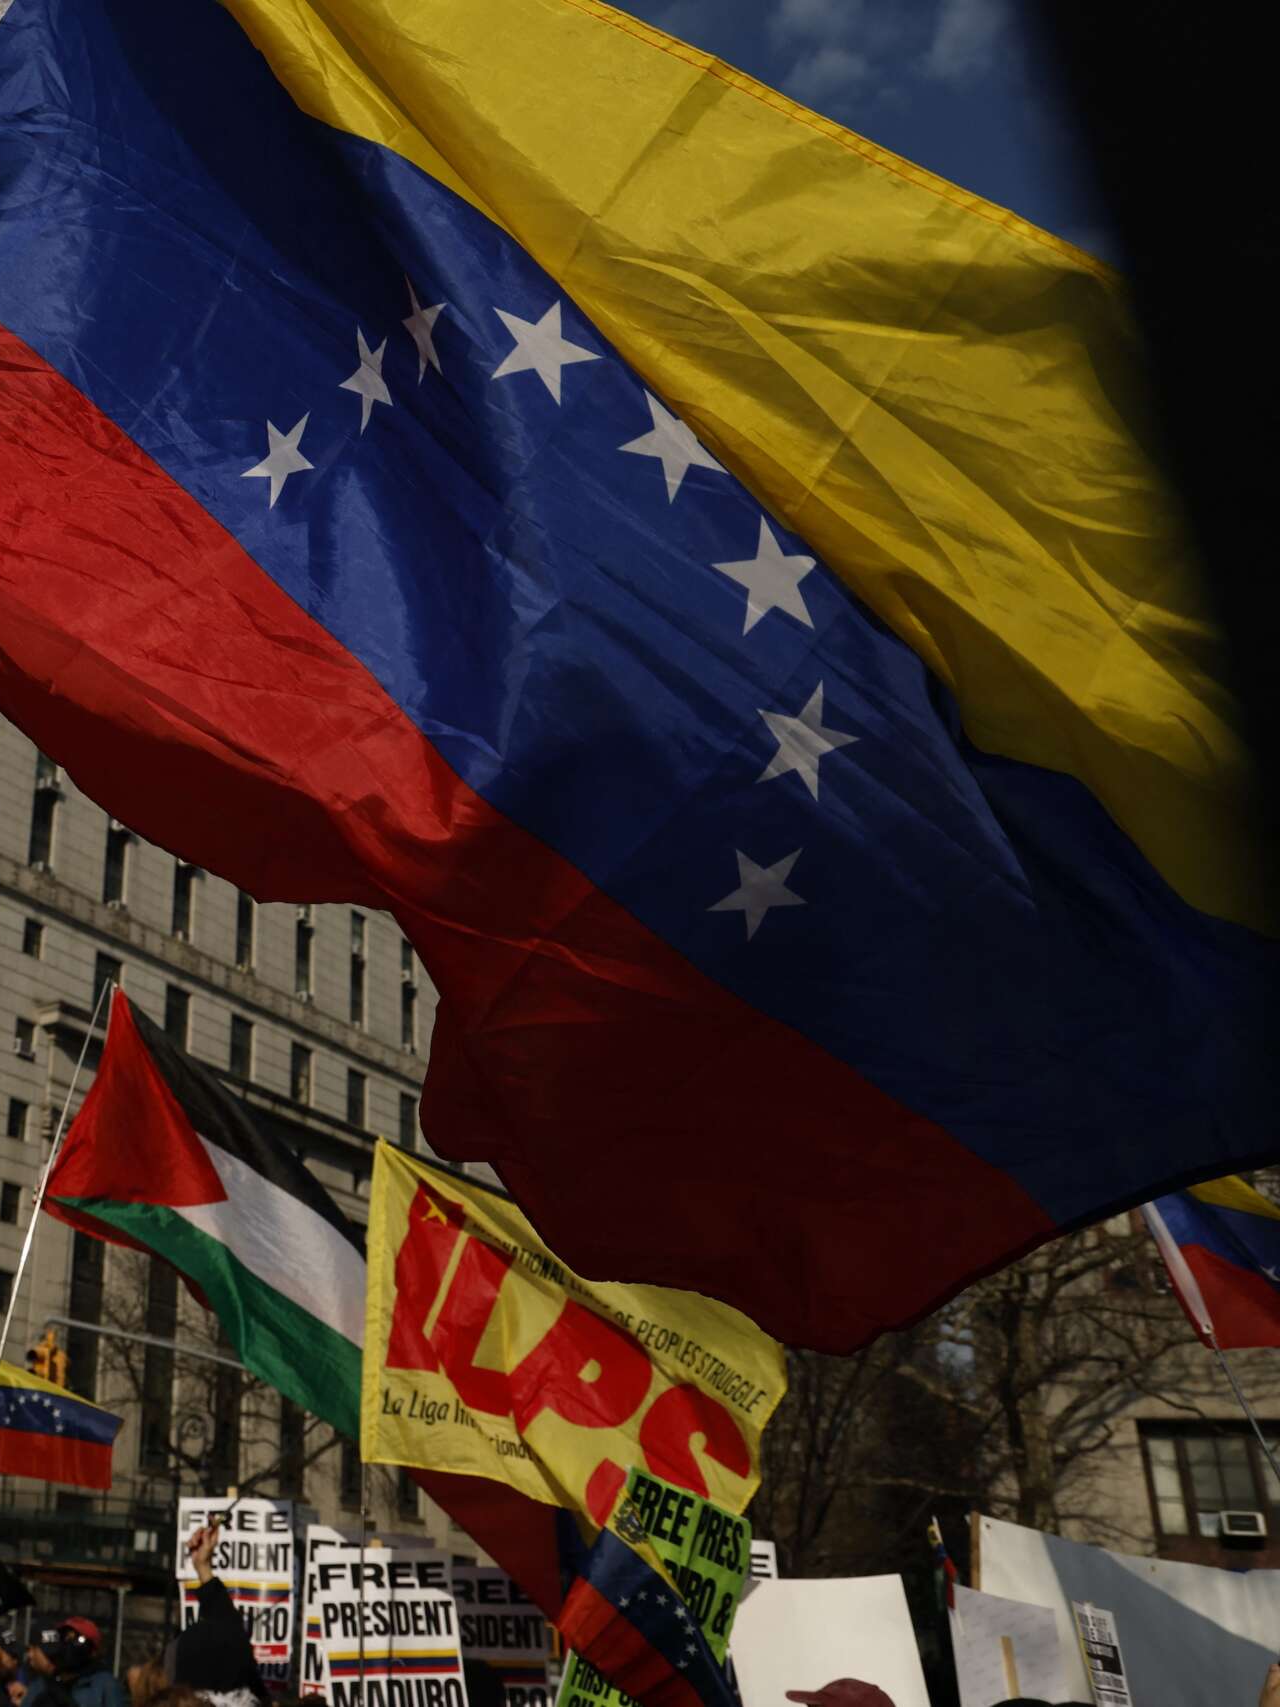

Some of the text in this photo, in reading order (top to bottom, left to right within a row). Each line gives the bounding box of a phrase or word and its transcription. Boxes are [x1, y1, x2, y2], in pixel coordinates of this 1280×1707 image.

[695, 1353, 767, 1414] STRUGGLE
[382, 1388, 402, 1416] La
[408, 1389, 450, 1426] Liga
[633, 1475, 695, 1547] FREE
[320, 1562, 448, 1590] FREE
[323, 1601, 453, 1639] PRESIDENT
[461, 1614, 545, 1649] SIDENT
[711, 1592, 733, 1637] &
[331, 1677, 466, 1707] MADURO
